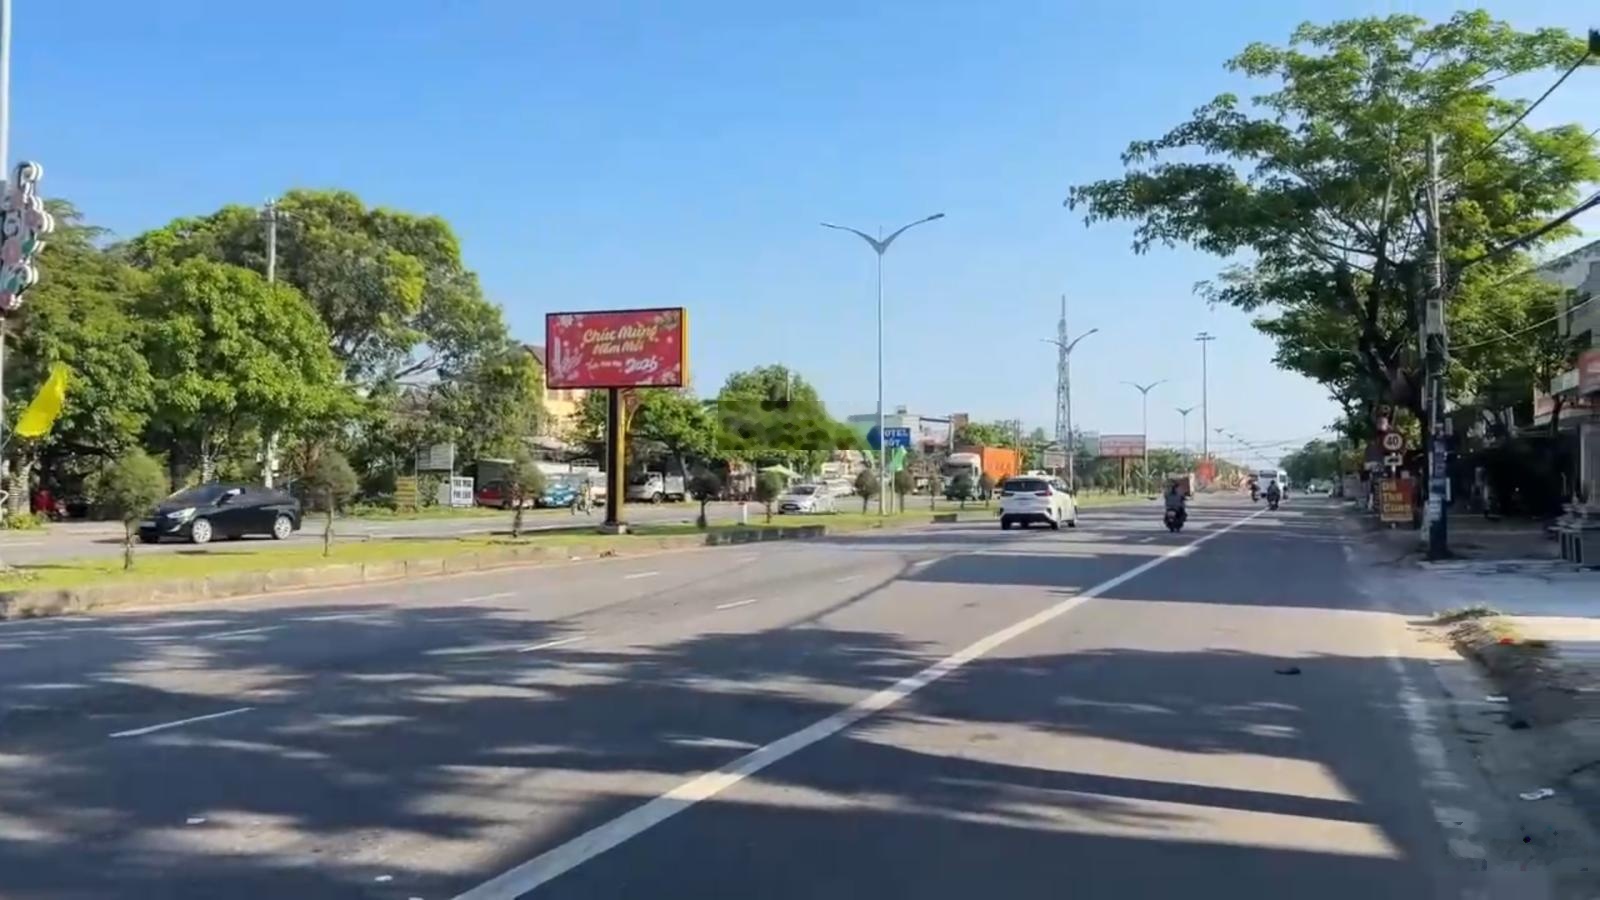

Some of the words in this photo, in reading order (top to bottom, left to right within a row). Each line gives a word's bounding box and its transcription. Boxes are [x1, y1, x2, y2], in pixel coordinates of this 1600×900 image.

[583, 327, 616, 343] Chúc
[624, 355, 658, 374] 2026
[1386, 435, 1399, 447] 40
